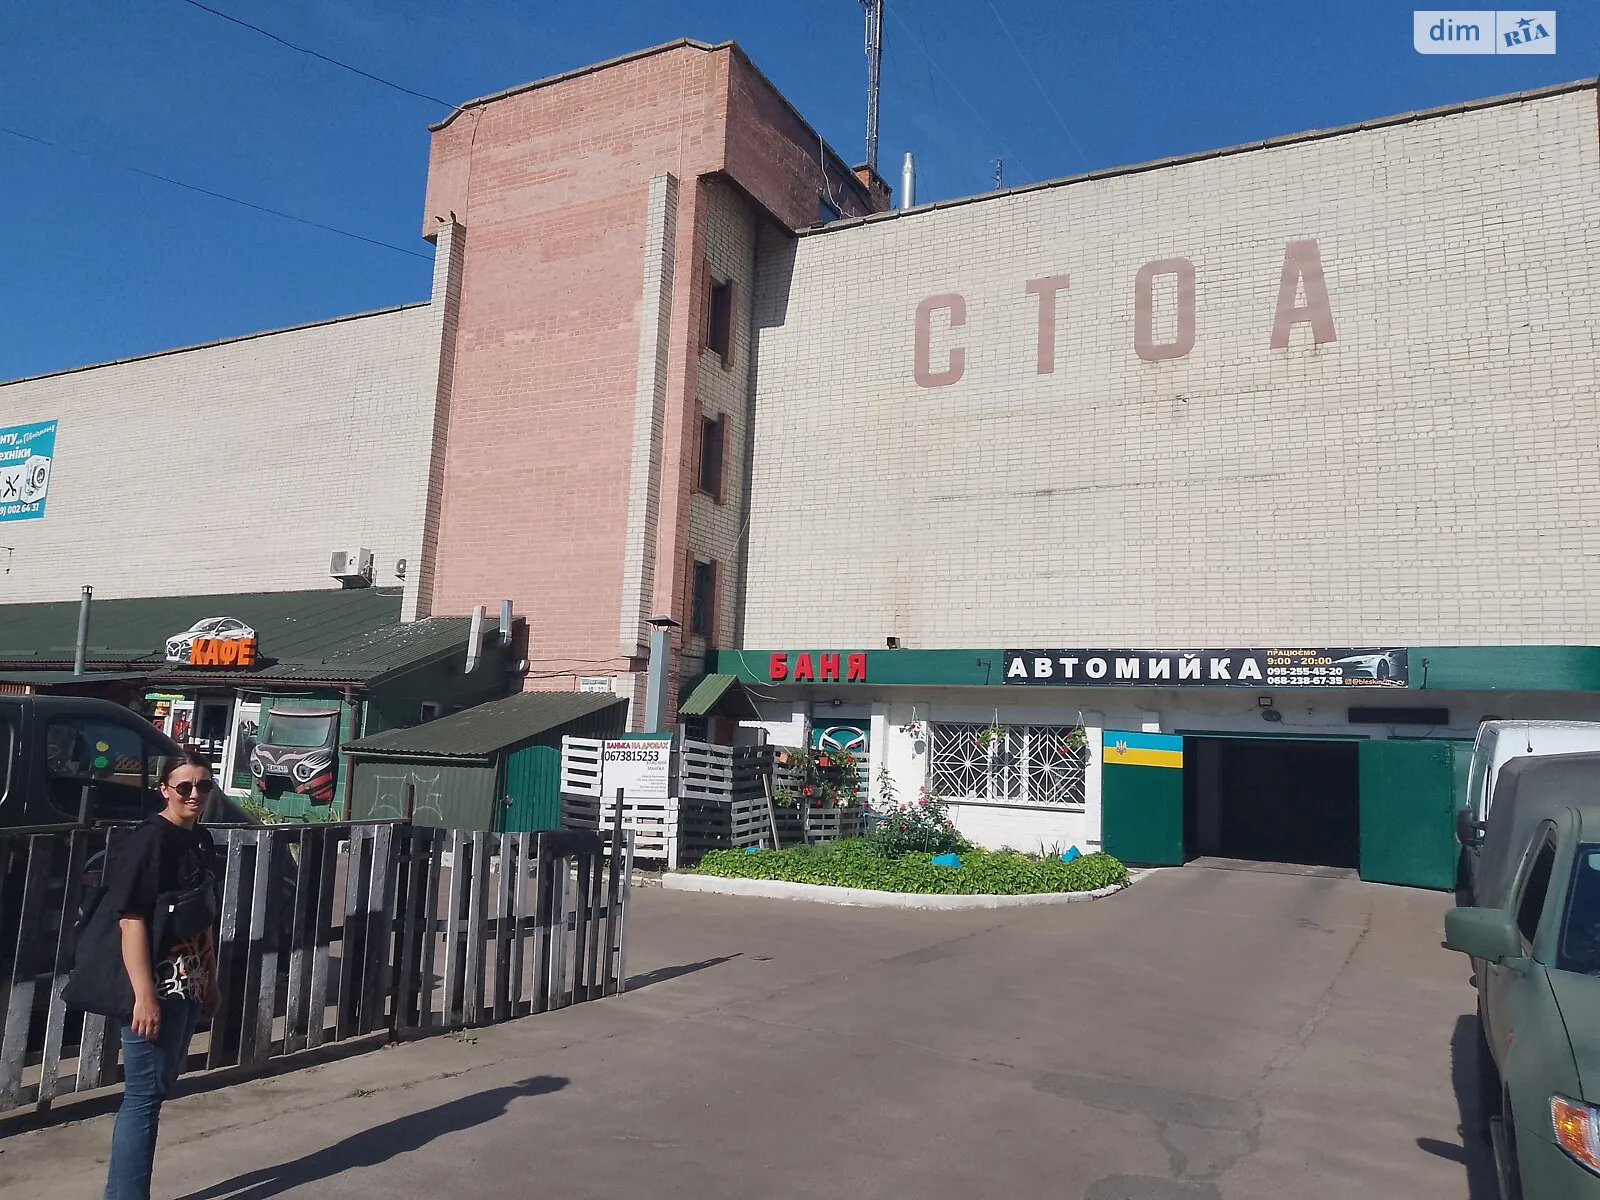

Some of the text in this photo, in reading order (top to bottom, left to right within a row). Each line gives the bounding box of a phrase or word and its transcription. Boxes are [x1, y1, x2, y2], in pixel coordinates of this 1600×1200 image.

[913, 237, 1338, 389] СТОА
[189, 637, 256, 665] КАФЕ
[769, 652, 867, 682] БАНЯ
[1007, 653, 1263, 680] АВТОМИЙКА
[1267, 657, 1291, 665] 9:00
[1300, 657, 1332, 665] 20:00
[1267, 667, 1343, 676] 095-255-45-20
[1267, 676, 1343, 685] 068-238-67-35
[604, 750, 659, 762] 0673815253
